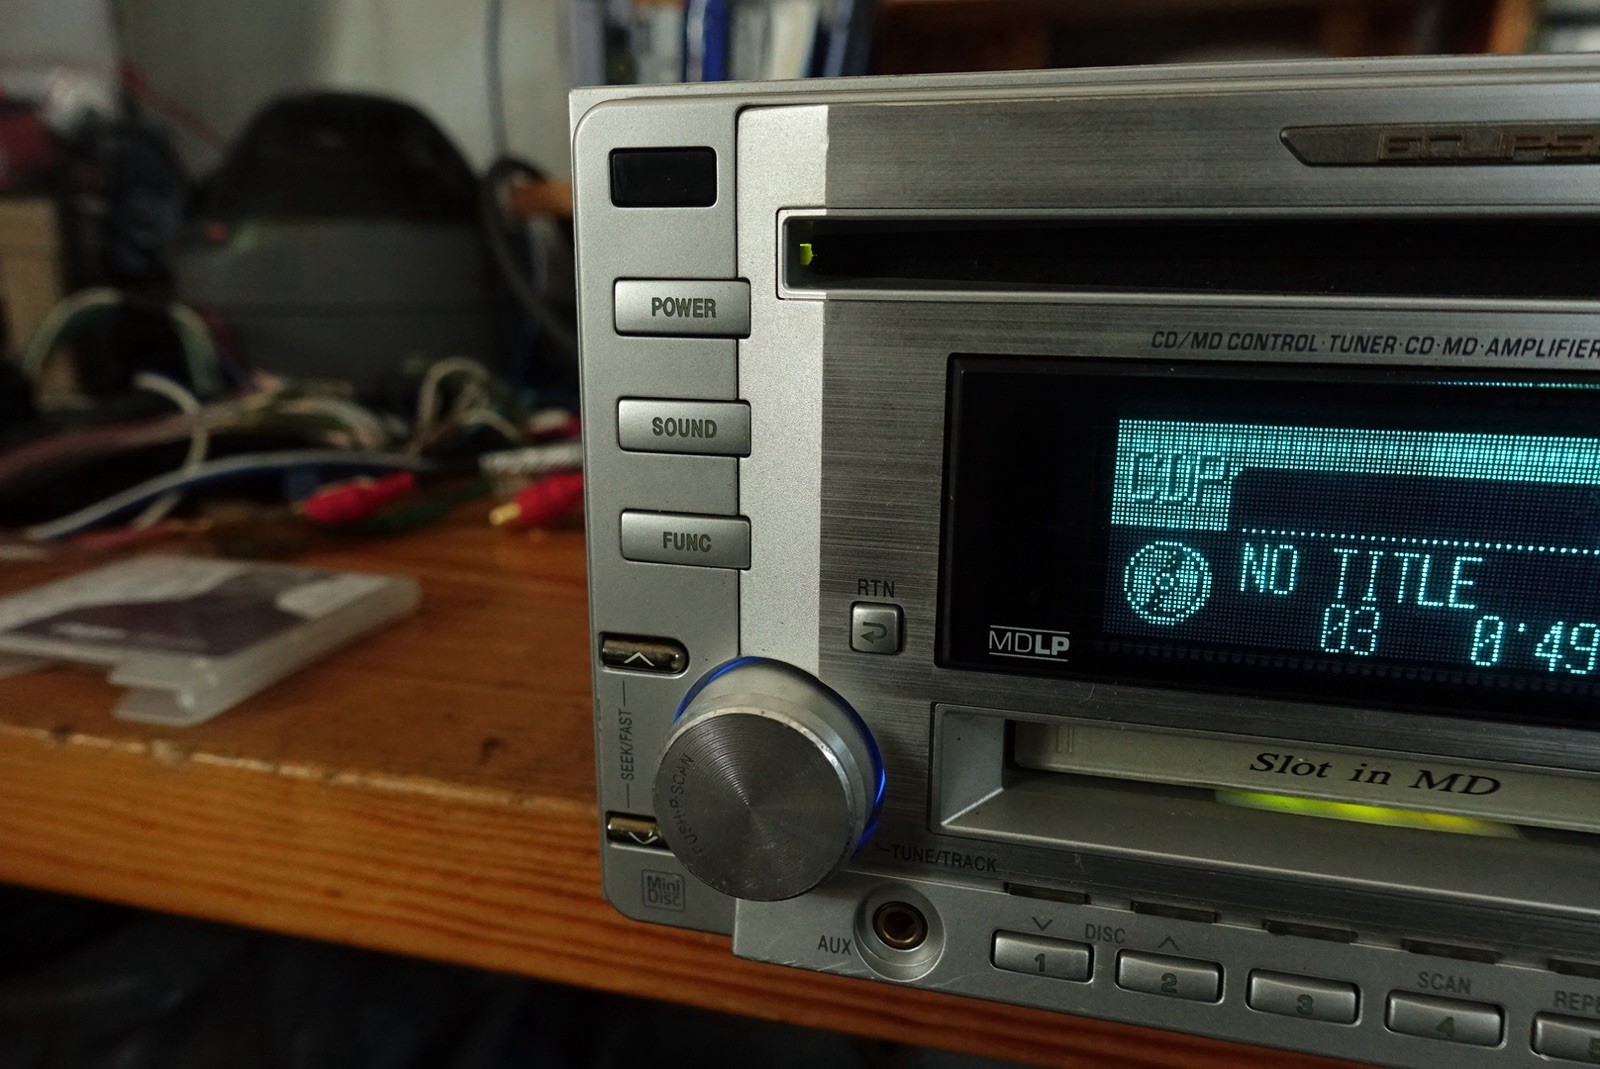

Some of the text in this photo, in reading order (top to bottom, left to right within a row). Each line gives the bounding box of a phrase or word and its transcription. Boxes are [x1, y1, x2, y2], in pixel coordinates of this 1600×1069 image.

[650, 297, 717, 319] POWER
[1151, 331, 1223, 350] CD/MD
[652, 416, 717, 439] SOUND
[662, 531, 712, 552] FUNC
[1239, 541, 1484, 610] NO TITLE
[857, 578, 896, 598] RTN
[1319, 603, 1381, 656] 03
[988, 630, 1070, 656] MDLP
[618, 708, 635, 781] SEEK/FAST
[1249, 752, 1501, 796] Slot in MD
[890, 843, 998, 873] TUNE/TRACK
[647, 875, 680, 893] Mini
[818, 934, 852, 956] AUX
[1085, 922, 1127, 945] DISC
[1034, 953, 1046, 973] 1
[1160, 972, 1179, 994] 2
[1417, 970, 1472, 994] SCAN
[1296, 993, 1314, 1018] 3
[1434, 1015, 1456, 1038] 4
